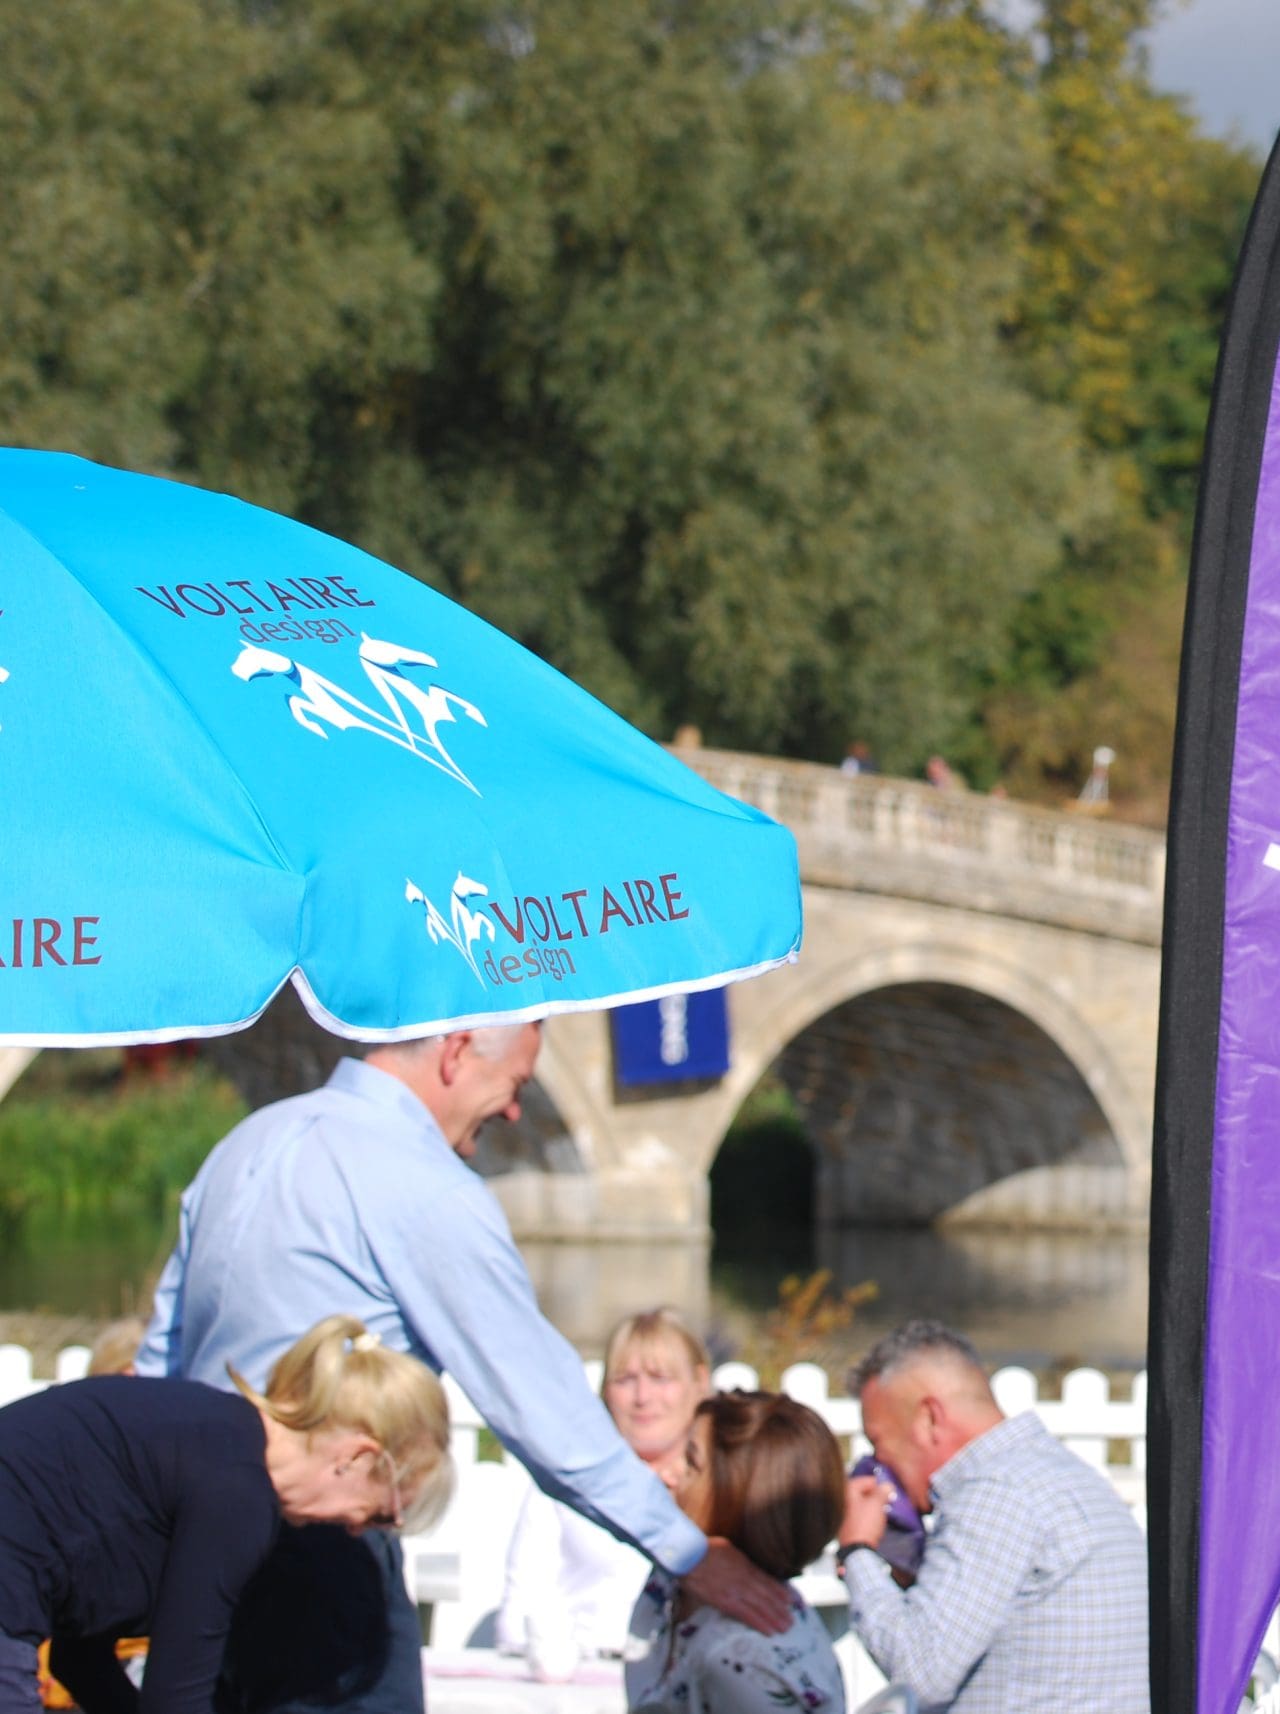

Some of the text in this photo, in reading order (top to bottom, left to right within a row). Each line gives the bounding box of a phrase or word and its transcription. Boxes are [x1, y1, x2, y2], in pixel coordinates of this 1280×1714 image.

[133, 575, 377, 619] VOLTAIRE
[236, 613, 358, 644] design
[488, 872, 690, 944] VOLTAIRE
[0, 915, 103, 968] IRE
[483, 937, 577, 986] design
